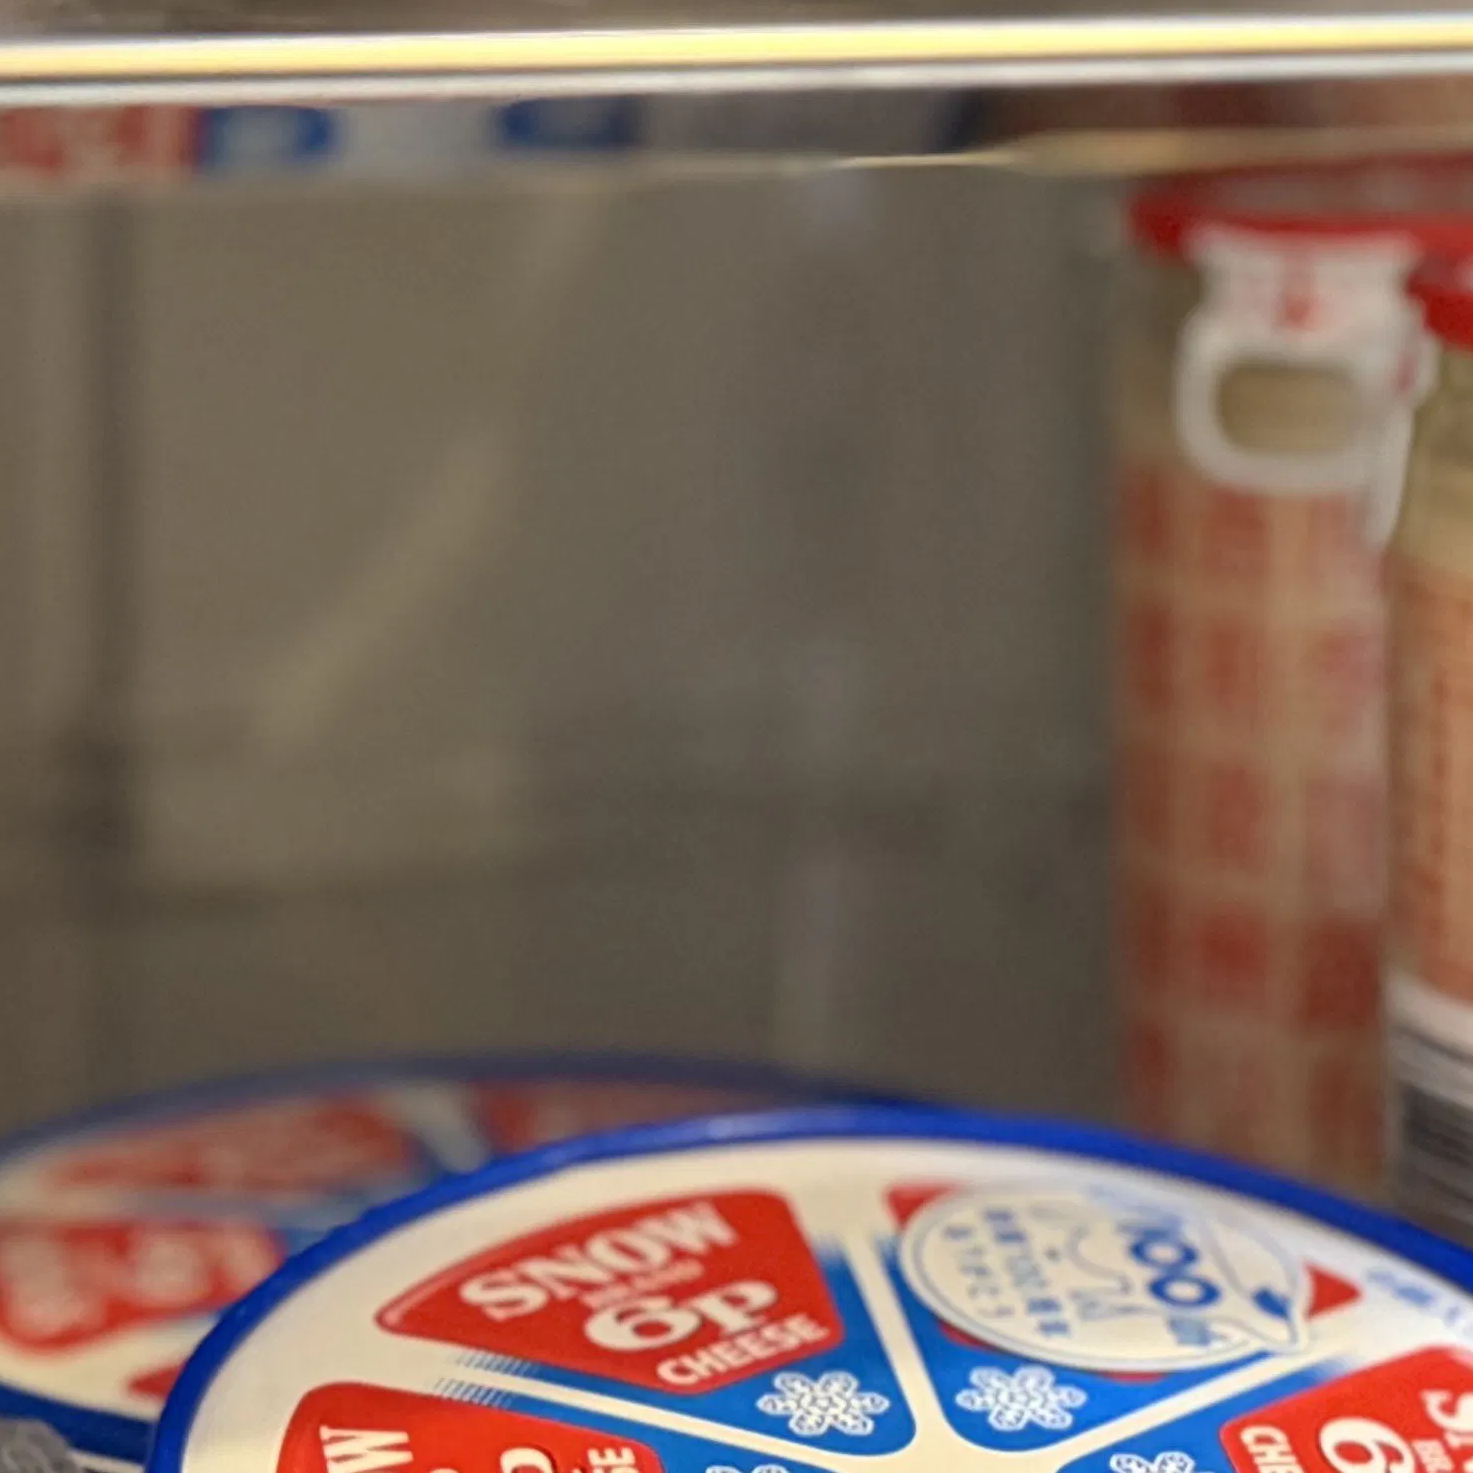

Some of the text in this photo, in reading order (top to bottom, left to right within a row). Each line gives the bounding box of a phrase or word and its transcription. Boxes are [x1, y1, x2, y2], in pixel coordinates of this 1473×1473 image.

[459, 1199, 738, 1321] SNOW
[584, 1279, 778, 1352] 6P
[656, 1312, 829, 1385] CHEESE
